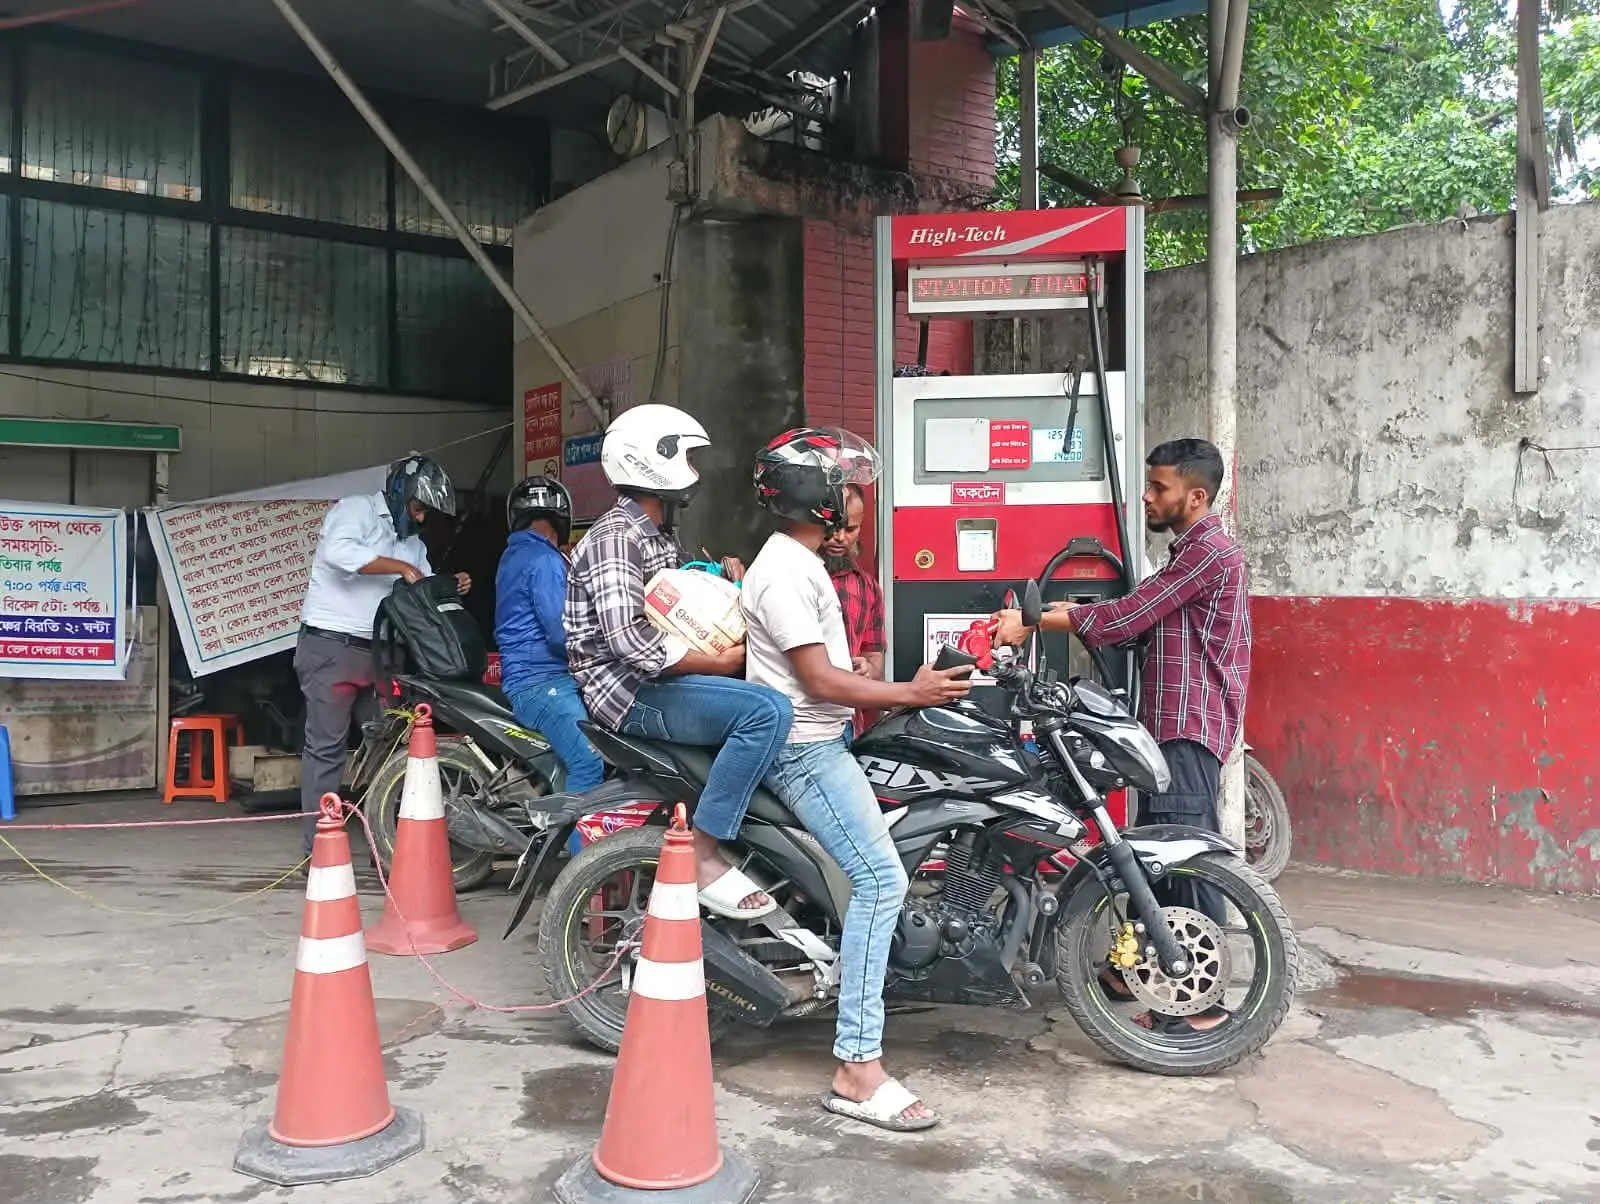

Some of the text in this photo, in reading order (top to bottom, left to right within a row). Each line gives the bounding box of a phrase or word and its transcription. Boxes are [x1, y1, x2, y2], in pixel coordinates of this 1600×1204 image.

[908, 225, 1006, 246] High-Tech
[917, 277, 1013, 298] STATION
[954, 485, 1001, 499] অকটেন
[166, 510, 201, 526] আপনার
[28, 520, 61, 536] পাম্প
[65, 522, 103, 536] থেকে
[246, 562, 281, 577] আপনার
[62, 581, 89, 594] এবং
[3, 595, 41, 612] বিকেল
[24, 618, 61, 633] বিরতি
[7, 644, 28, 656] তেল
[63, 646, 85, 657] হবে
[87, 647, 99, 657] না
